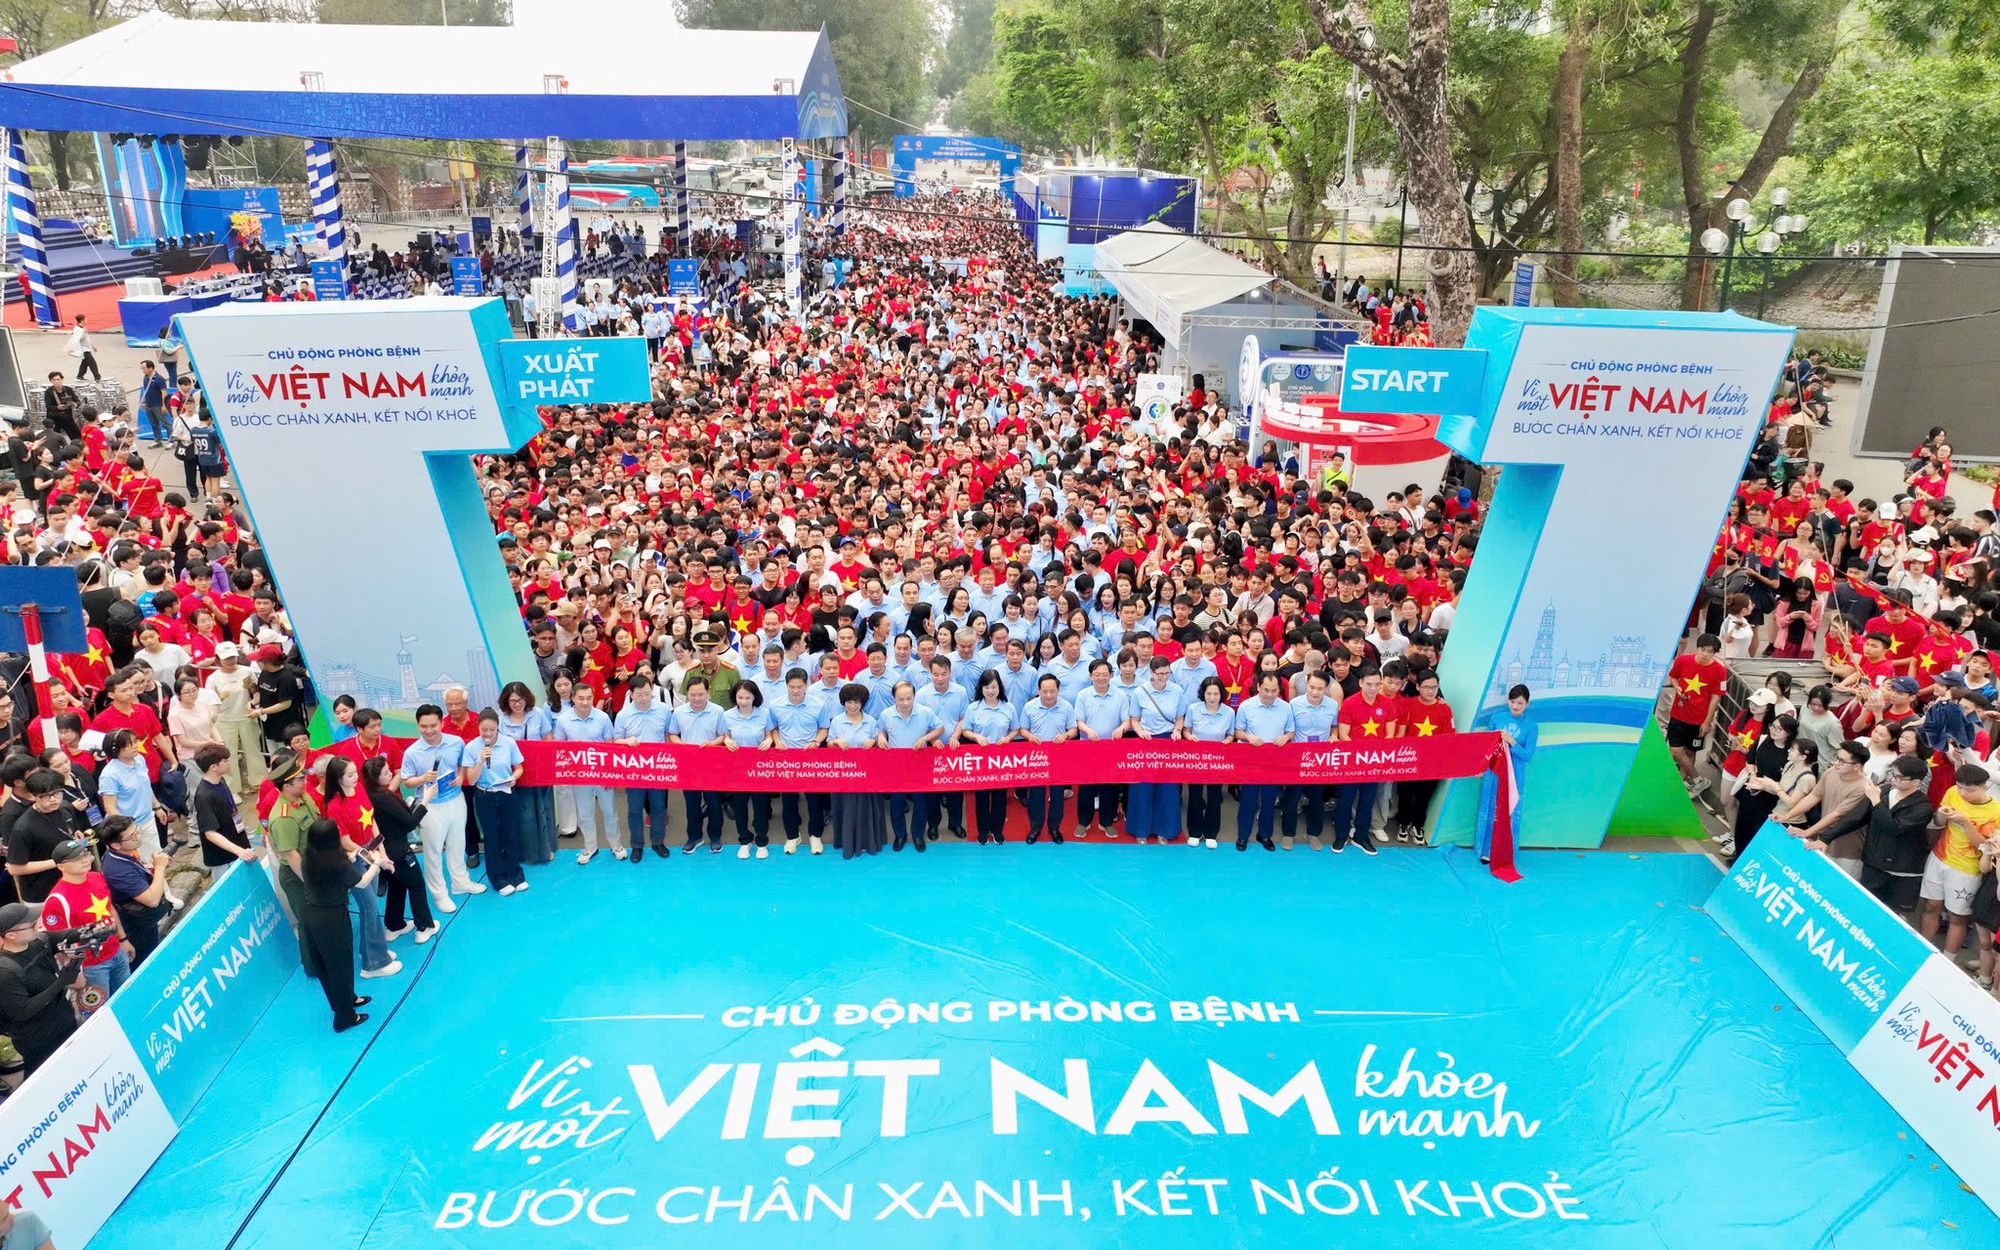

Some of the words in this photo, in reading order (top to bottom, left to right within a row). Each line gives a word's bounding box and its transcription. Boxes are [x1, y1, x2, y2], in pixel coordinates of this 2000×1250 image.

[268, 347, 295, 360] CHỦ
[298, 348, 335, 361] ĐỘNG
[339, 347, 383, 359] PHÒNG
[386, 345, 421, 359] BỆNH
[523, 345, 600, 374] XUẤT
[1571, 360, 1596, 372] CHỦ
[1599, 361, 1633, 374] ĐỘNG
[1636, 362, 1678, 374] PHÒNG
[1680, 363, 1713, 376] BỆNH
[226, 371, 244, 390] Vì
[252, 364, 330, 409] VIỆT
[341, 370, 427, 399] NAM
[429, 383, 474, 401] mạnh
[518, 373, 594, 399] PHÁT
[1350, 369, 1449, 393] START
[1522, 378, 1541, 398] Vì
[227, 386, 262, 408] một
[1517, 395, 1550, 415] một
[1549, 375, 1621, 419] VIỆT
[1628, 387, 1708, 414] NAM
[231, 412, 273, 427] BƯỚC
[276, 410, 322, 426] CHÂN
[324, 411, 371, 425] XANH,
[375, 408, 400, 422] KẾT
[405, 406, 432, 422] NỐI
[1707, 402, 1749, 420] mạnh
[1513, 419, 1552, 435] BƯỚC
[1556, 421, 1597, 436] CHÂN
[1600, 425, 1643, 438] XANH,
[1648, 423, 1673, 438] KẾT
[1676, 424, 1702, 438] NỐI
[568, 747, 608, 770] VIỆT
[613, 752, 654, 769] NAM
[756, 760, 774, 769] CHỦ
[776, 760, 800, 770] ĐỘNG
[802, 761, 832, 769] PHÒNG
[834, 760, 857, 770] BỆNH
[946, 752, 983, 775] VIỆT
[988, 755, 1028, 770] NAM
[1117, 761, 1126, 769] VÌ
[1127, 761, 1144, 770] MỘT
[1146, 762, 1164, 770] VIỆT
[1210, 762, 1234, 770] MẠNH
[1126, 750, 1144, 760] CHỦ
[1146, 752, 1170, 760] ĐỘNG
[1172, 752, 1200, 760] PHÒNG
[1202, 753, 1224, 761] BỆNH
[1314, 748, 1351, 770] VIỆT
[1356, 750, 1396, 765] NAM
[555, 770, 576, 778] BƯỚC
[578, 770, 600, 778] CHÂN
[626, 771, 640, 780] KẾT
[642, 772, 656, 782] NỐI
[747, 769, 756, 778] VÌ
[758, 770, 775, 778] MỘT
[777, 770, 795, 779] VIỆT
[842, 771, 866, 779] MẠNH
[933, 776, 954, 784] BƯỚC
[954, 776, 976, 784] CHÂN
[1000, 773, 1014, 781] KẾT
[1016, 772, 1029, 780] NỐI
[1368, 768, 1381, 776] KẾT
[1382, 767, 1396, 775] NỐI
[1782, 865, 1801, 883] CHỦ
[1798, 879, 1822, 904] ĐỘNG
[1820, 899, 1851, 929] PHÒNG
[1848, 924, 1875, 950] BỆNH
[1755, 872, 1805, 928] VIỆT
[1796, 917, 1861, 984] NAM
[163, 974, 181, 999] CHỦ
[179, 953, 203, 980] ĐỘNG
[201, 923, 227, 955] PHÒNG
[225, 902, 245, 928] BỆNH
[161, 976, 214, 1043] VIỆT
[211, 922, 262, 992] NAM
[721, 997, 822, 1028] CHỦ
[833, 998, 972, 1030] ĐỘNG
[996, 996, 1156, 1023] PHÒNG
[1170, 996, 1302, 1028] BỆNH
[1898, 1001, 1920, 1022] Vì
[1886, 1017, 1919, 1042] một
[1952, 1014, 1976, 1037] CHỦ
[1974, 1034, 2000, 1065] ĐỘN
[1917, 1019, 1985, 1092] VIỆT
[506, 1054, 594, 1111] Vì
[111, 1083, 144, 1124] mạnh
[626, 1036, 940, 1167] VIỆT
[990, 1055, 1342, 1136] NAM
[0, 1153, 17, 1176] NG
[17, 1110, 58, 1156] PHÒNG
[57, 1079, 88, 1114] BỆNH
[471, 1096, 632, 1165] một
[1357, 1104, 1541, 1150] mạnh
[32, 1102, 112, 1200] NAM
[434, 1178, 637, 1229] BƯỚC
[655, 1176, 854, 1224] CHÂN
[874, 1180, 1092, 1222] XANH,
[1115, 1166, 1228, 1216] KẾT
[1253, 1166, 1380, 1216] NỐI
[1392, 1170, 1590, 1221] KHOẺ
